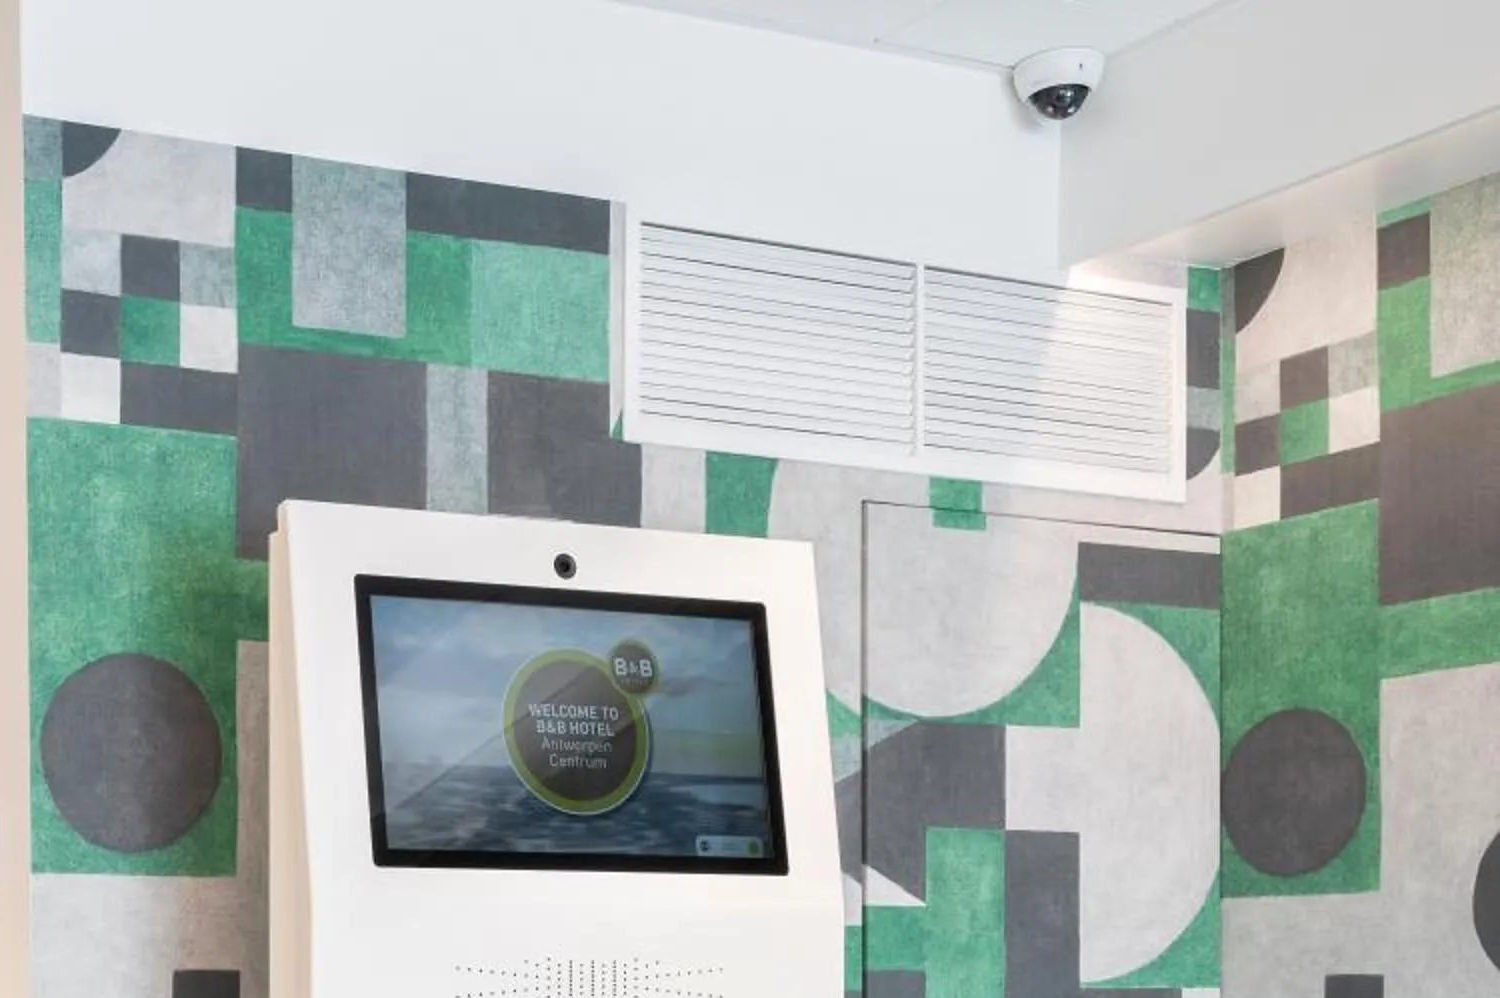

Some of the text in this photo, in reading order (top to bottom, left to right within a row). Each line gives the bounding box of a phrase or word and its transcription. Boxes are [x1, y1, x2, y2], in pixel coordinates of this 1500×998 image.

[615, 657, 653, 677] B&B
[528, 703, 619, 721] WELCOME TO
[536, 719, 616, 737] B&B HOTEL
[541, 736, 613, 756] Antwerpen
[549, 753, 609, 769] Centrum
